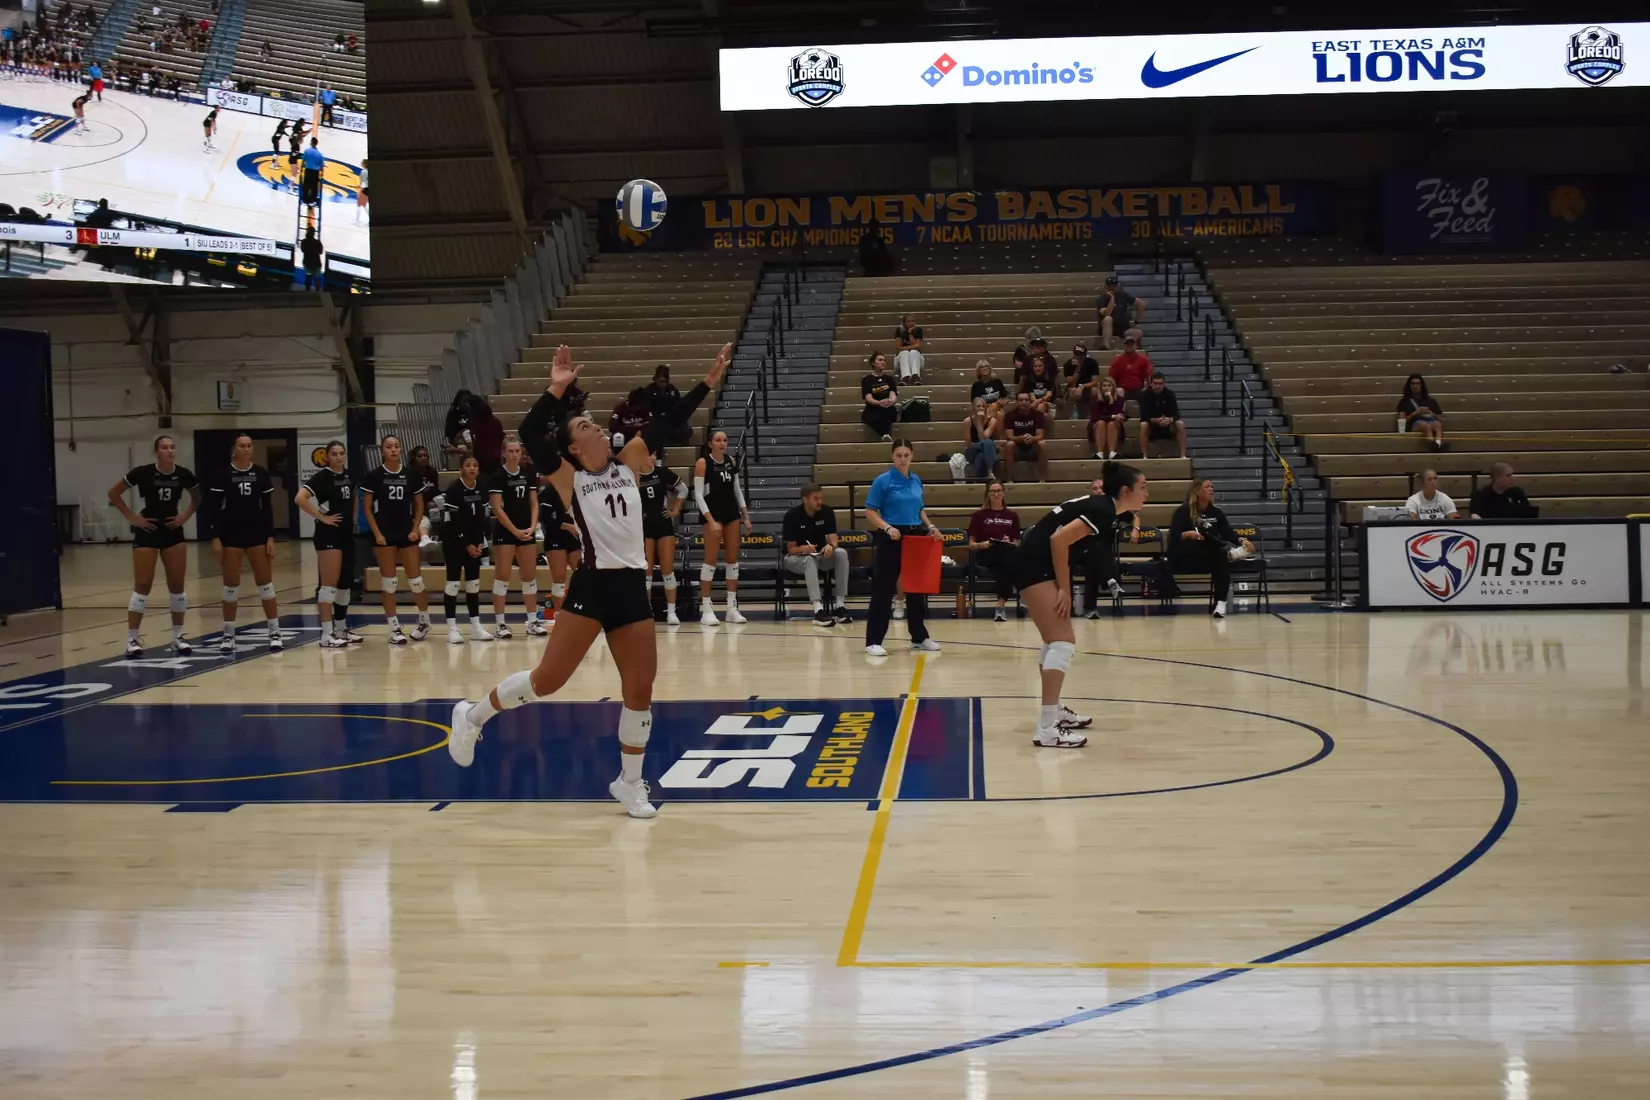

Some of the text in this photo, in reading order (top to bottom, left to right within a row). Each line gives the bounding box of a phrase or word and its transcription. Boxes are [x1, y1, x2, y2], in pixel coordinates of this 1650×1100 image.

[1312, 37, 1485, 52] EAST TEXAS A&M
[1569, 46, 1620, 61] LOREDO
[1312, 49, 1486, 82] LIONS
[791, 67, 840, 83] LOREDO
[962, 61, 1094, 86] Domino's
[1415, 177, 1489, 214] Fix &
[702, 185, 1296, 228] LION MEN'S BASKETBALL
[1428, 206, 1496, 239] Feed
[65, 230, 73, 240] 3
[100, 231, 190, 247] ULM 1
[916, 226, 926, 243] 7
[931, 226, 972, 243] NCAA
[978, 222, 1092, 242] TOURNAMENTS
[197, 239, 208, 248] SIU
[209, 240, 228, 249] LEADS
[229, 241, 239, 249] 2-1
[719, 470, 732, 482] 14
[158, 487, 172, 501] 13
[238, 482, 252, 495] 15
[340, 485, 351, 499] 18
[388, 486, 404, 500] 20
[515, 485, 526, 498] 17
[646, 486, 655, 499] 9
[471, 502, 476, 515] 1
[604, 493, 628, 518] 11
[742, 536, 773, 544] LIONS
[1123, 530, 1157, 539] LNS
[1481, 542, 1567, 577] ASG
[805, 711, 876, 789] SOUTHLAND
